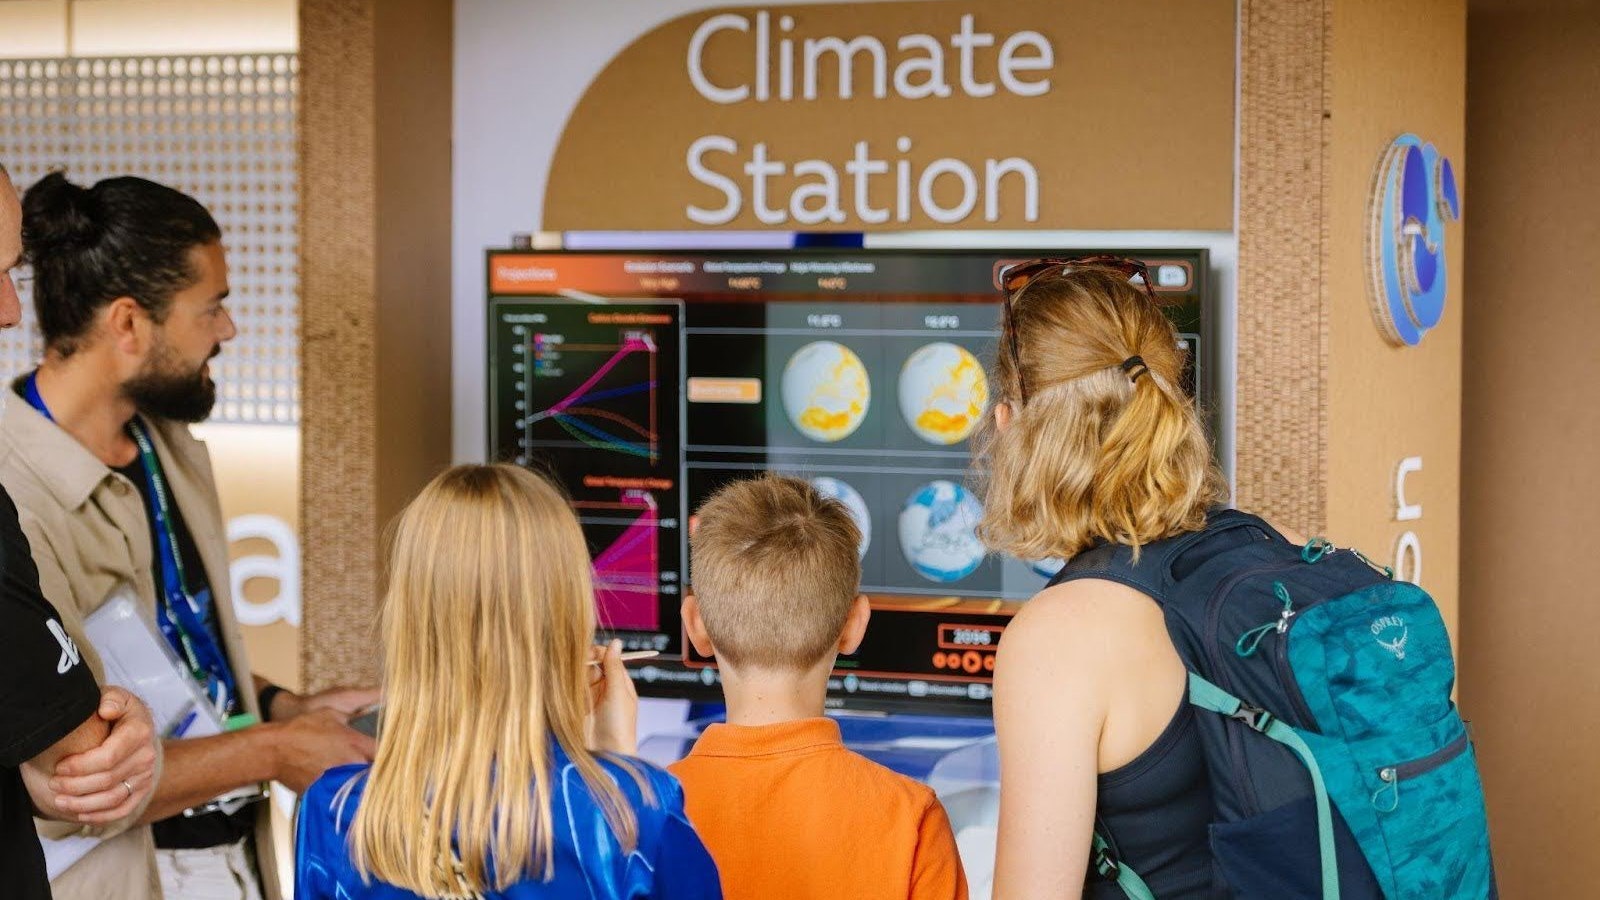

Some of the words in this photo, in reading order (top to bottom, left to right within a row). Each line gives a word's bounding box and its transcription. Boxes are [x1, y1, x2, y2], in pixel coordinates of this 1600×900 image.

[687, 11, 1054, 102] Climate
[686, 135, 1040, 224] Station
[1370, 616, 1404, 635] OSPREY
